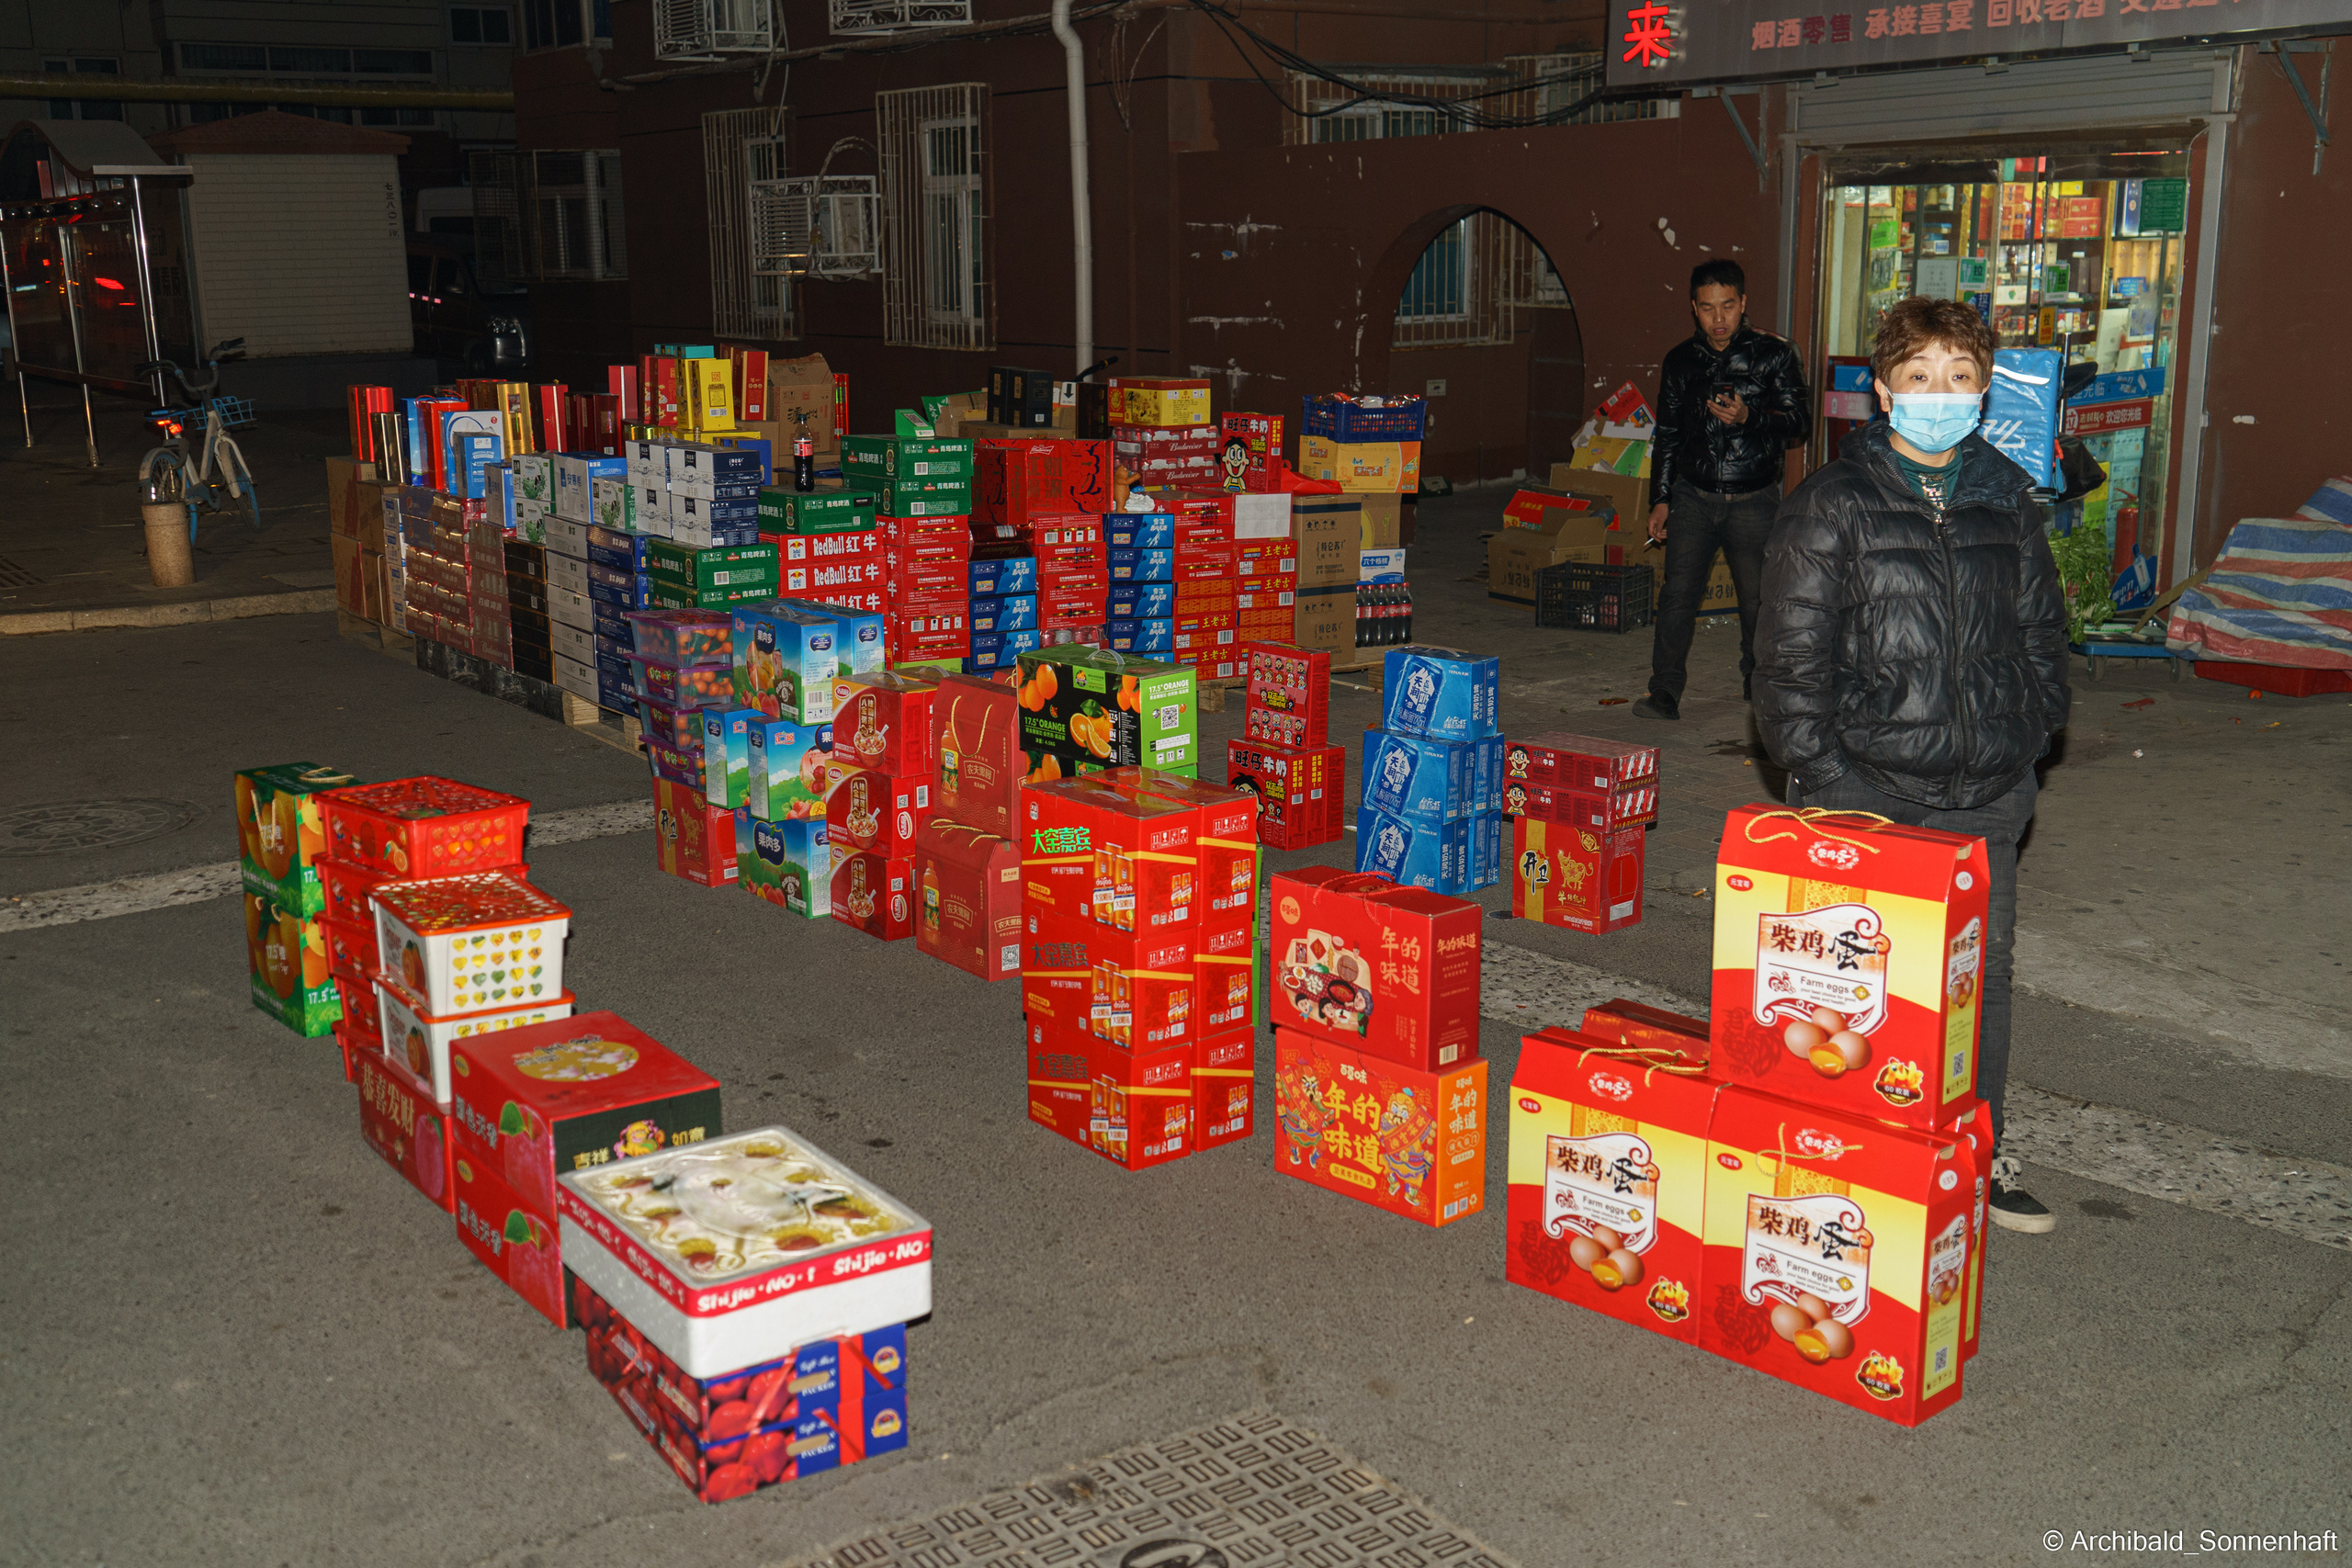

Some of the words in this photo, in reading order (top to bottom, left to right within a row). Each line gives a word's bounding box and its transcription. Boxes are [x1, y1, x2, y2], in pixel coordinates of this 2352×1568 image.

[1623, 1, 1670, 67] 来
[1752, 14, 1852, 50] 烟酒零售
[1864, 0, 1973, 39] 承接喜宴
[1228, 418, 1269, 434] 旺仔牛奶
[2106, 407, 2143, 424] 欢迎您光临
[858, 452, 879, 464] 青岛啤酒
[1169, 441, 1203, 453] Budweiser
[1166, 469, 1200, 481] Budweiser
[826, 499, 850, 507] 青岛啤酒
[741, 549, 766, 558] 青岛啤酒
[812, 537, 845, 557] RedBull
[846, 534, 877, 553] 红牛
[1264, 545, 1291, 558] 王老吉
[1321, 541, 1340, 552] 特仑苏
[661, 557, 680, 572] 青岛啤酒
[1363, 557, 1388, 566] 六个核桃
[813, 568, 846, 586] RedBull
[848, 563, 879, 582] 红牛
[1264, 578, 1290, 590] 王老吉
[742, 588, 766, 597] 青岛啤酒
[1202, 615, 1228, 628] 王老吉
[757, 629, 774, 644] 果肉多
[1201, 649, 1228, 661] 王老吉
[1164, 680, 1190, 691] ORANGE
[1409, 676, 1423, 700] 天润
[1416, 691, 1430, 714] 奶啤
[1472, 683, 1480, 721] 天润奶啤
[1487, 686, 1495, 727] 天润奶啤
[1039, 719, 1066, 732] ORANGE
[967, 763, 992, 780] 农夫果园
[1235, 750, 1287, 778] 旺仔牛奶
[1385, 756, 1399, 780] 天润
[1392, 772, 1405, 795] 奶啤
[757, 830, 781, 854] 果肉多
[1031, 826, 1091, 854] 大窑嘉宾
[1380, 832, 1394, 855] 天润
[1386, 847, 1400, 870] 奶啤
[1457, 845, 1465, 885] 天润奶啤
[1816, 848, 1852, 863] 柴鸡蛋
[946, 903, 970, 920] 农夫果园
[1282, 903, 1299, 917] 百草味
[998, 917, 1022, 930] 农夫果园
[1031, 942, 1089, 967] 大窑嘉宾
[1380, 925, 1421, 963] 年的
[1436, 931, 1476, 955] 年的味道
[1770, 923, 1878, 971] 柴鸡蛋
[1379, 961, 1421, 995] 味道
[1801, 976, 1824, 988] Farm
[1826, 984, 1849, 994] eggs
[1035, 1052, 1089, 1080] 大窑嘉宾
[1340, 1064, 1367, 1085] 百草味
[1455, 1076, 1473, 1089] 百草味
[1884, 1086, 1894, 1094] 60
[1895, 1088, 1910, 1097] 枚装
[361, 1061, 415, 1137] 恭喜发财
[1322, 1079, 1382, 1132] 年的
[1449, 1089, 1477, 1114] 年的
[1449, 1111, 1477, 1134] 味道
[672, 1125, 706, 1146] 如意
[573, 1145, 610, 1170] 吉祥
[1322, 1122, 1385, 1175] 味道
[1556, 1145, 1647, 1195] 柴鸡蛋
[1583, 1195, 1602, 1208] Farm
[1605, 1204, 1624, 1215] eggs
[1758, 1206, 1860, 1261] 柴鸡蛋
[1787, 1260, 1809, 1275] Farm
[1812, 1270, 1834, 1283] eggs
[1866, 1378, 1876, 1387] 60
[1876, 1381, 1891, 1393] 枚装
